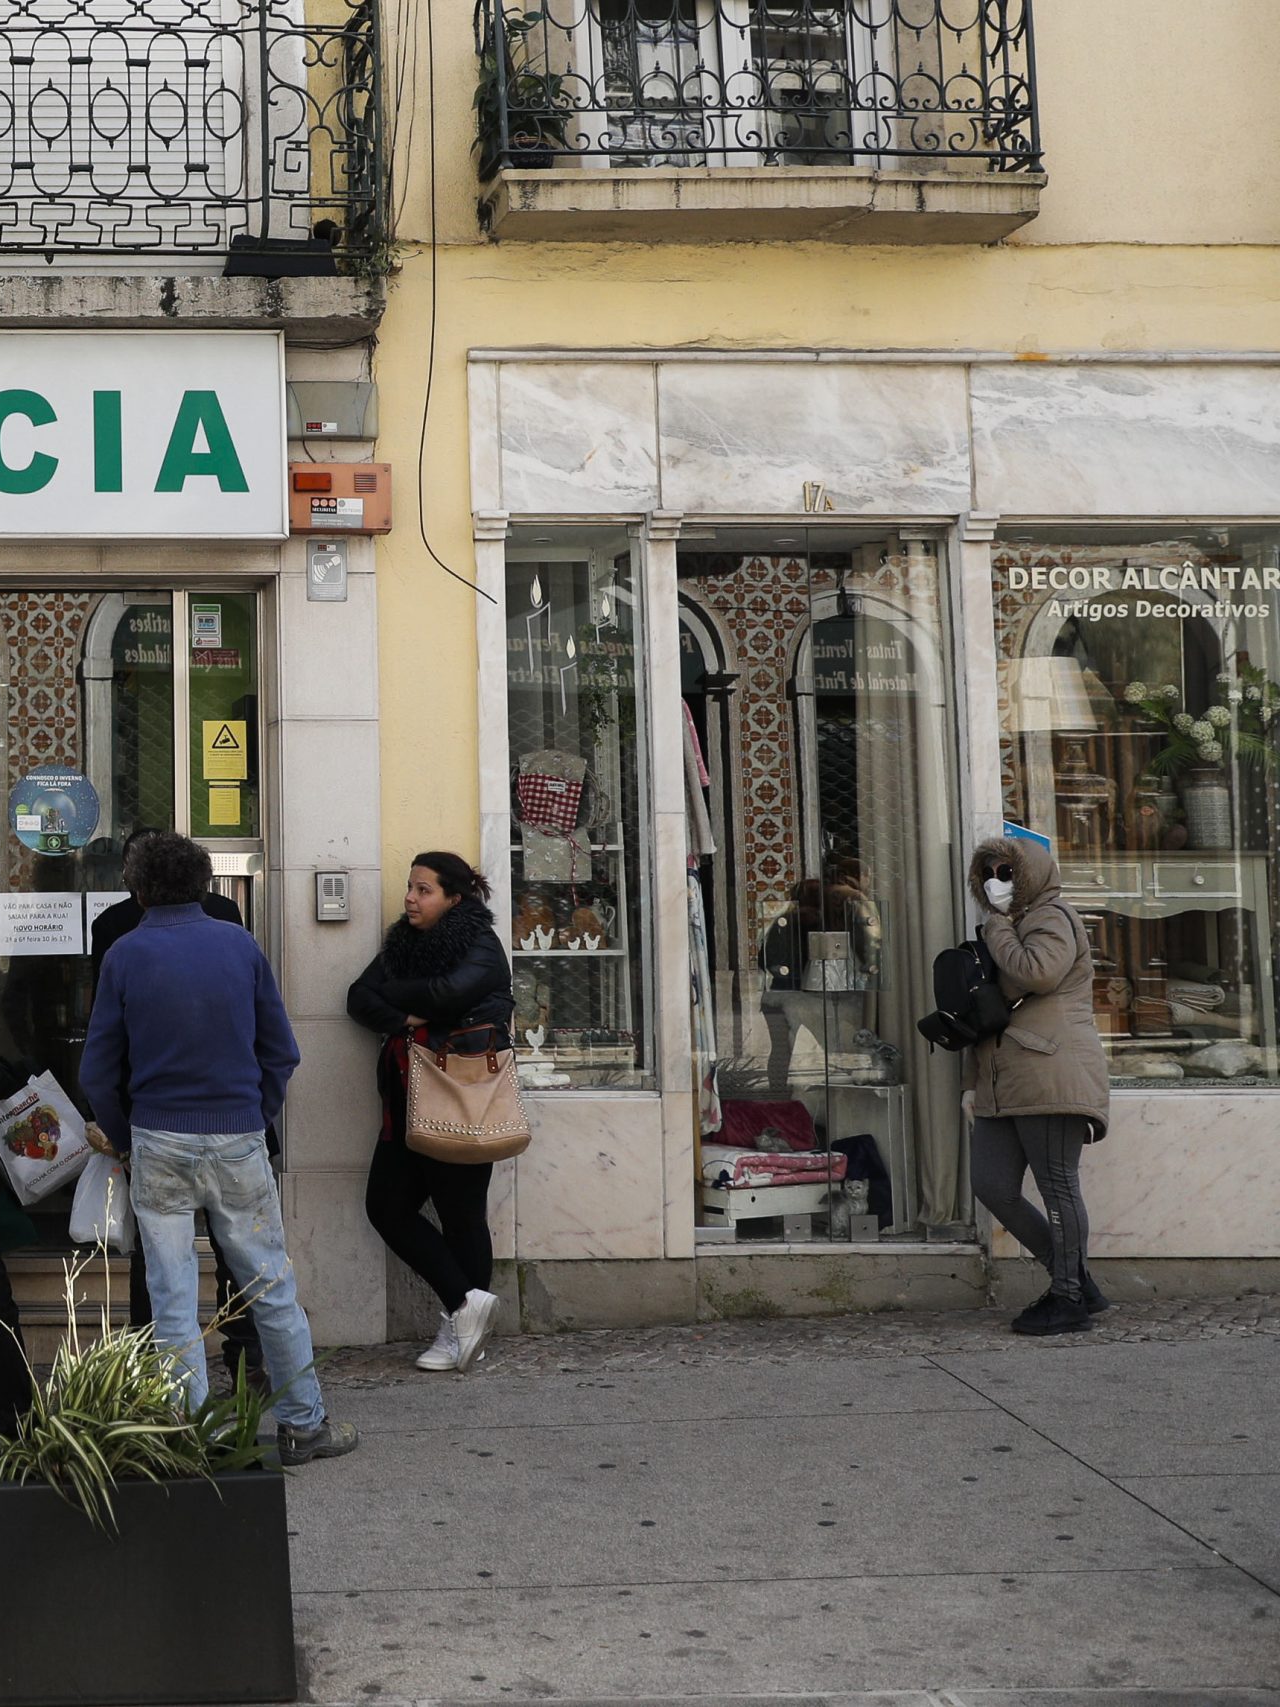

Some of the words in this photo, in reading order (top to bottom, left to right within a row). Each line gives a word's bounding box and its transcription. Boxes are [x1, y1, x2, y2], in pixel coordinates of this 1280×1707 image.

[1008, 567, 1113, 590] DECOR
[1121, 560, 1280, 590] ALCÂNTAR
[1046, 600, 1128, 622] Artigos
[1135, 601, 1270, 618] Decorativos
[3, 902, 17, 910] VÃO
[58, 901, 73, 909] NÃO
[33, 923, 64, 931] HORÁRIO
[64, 1143, 90, 1166] CORAÇÃO
